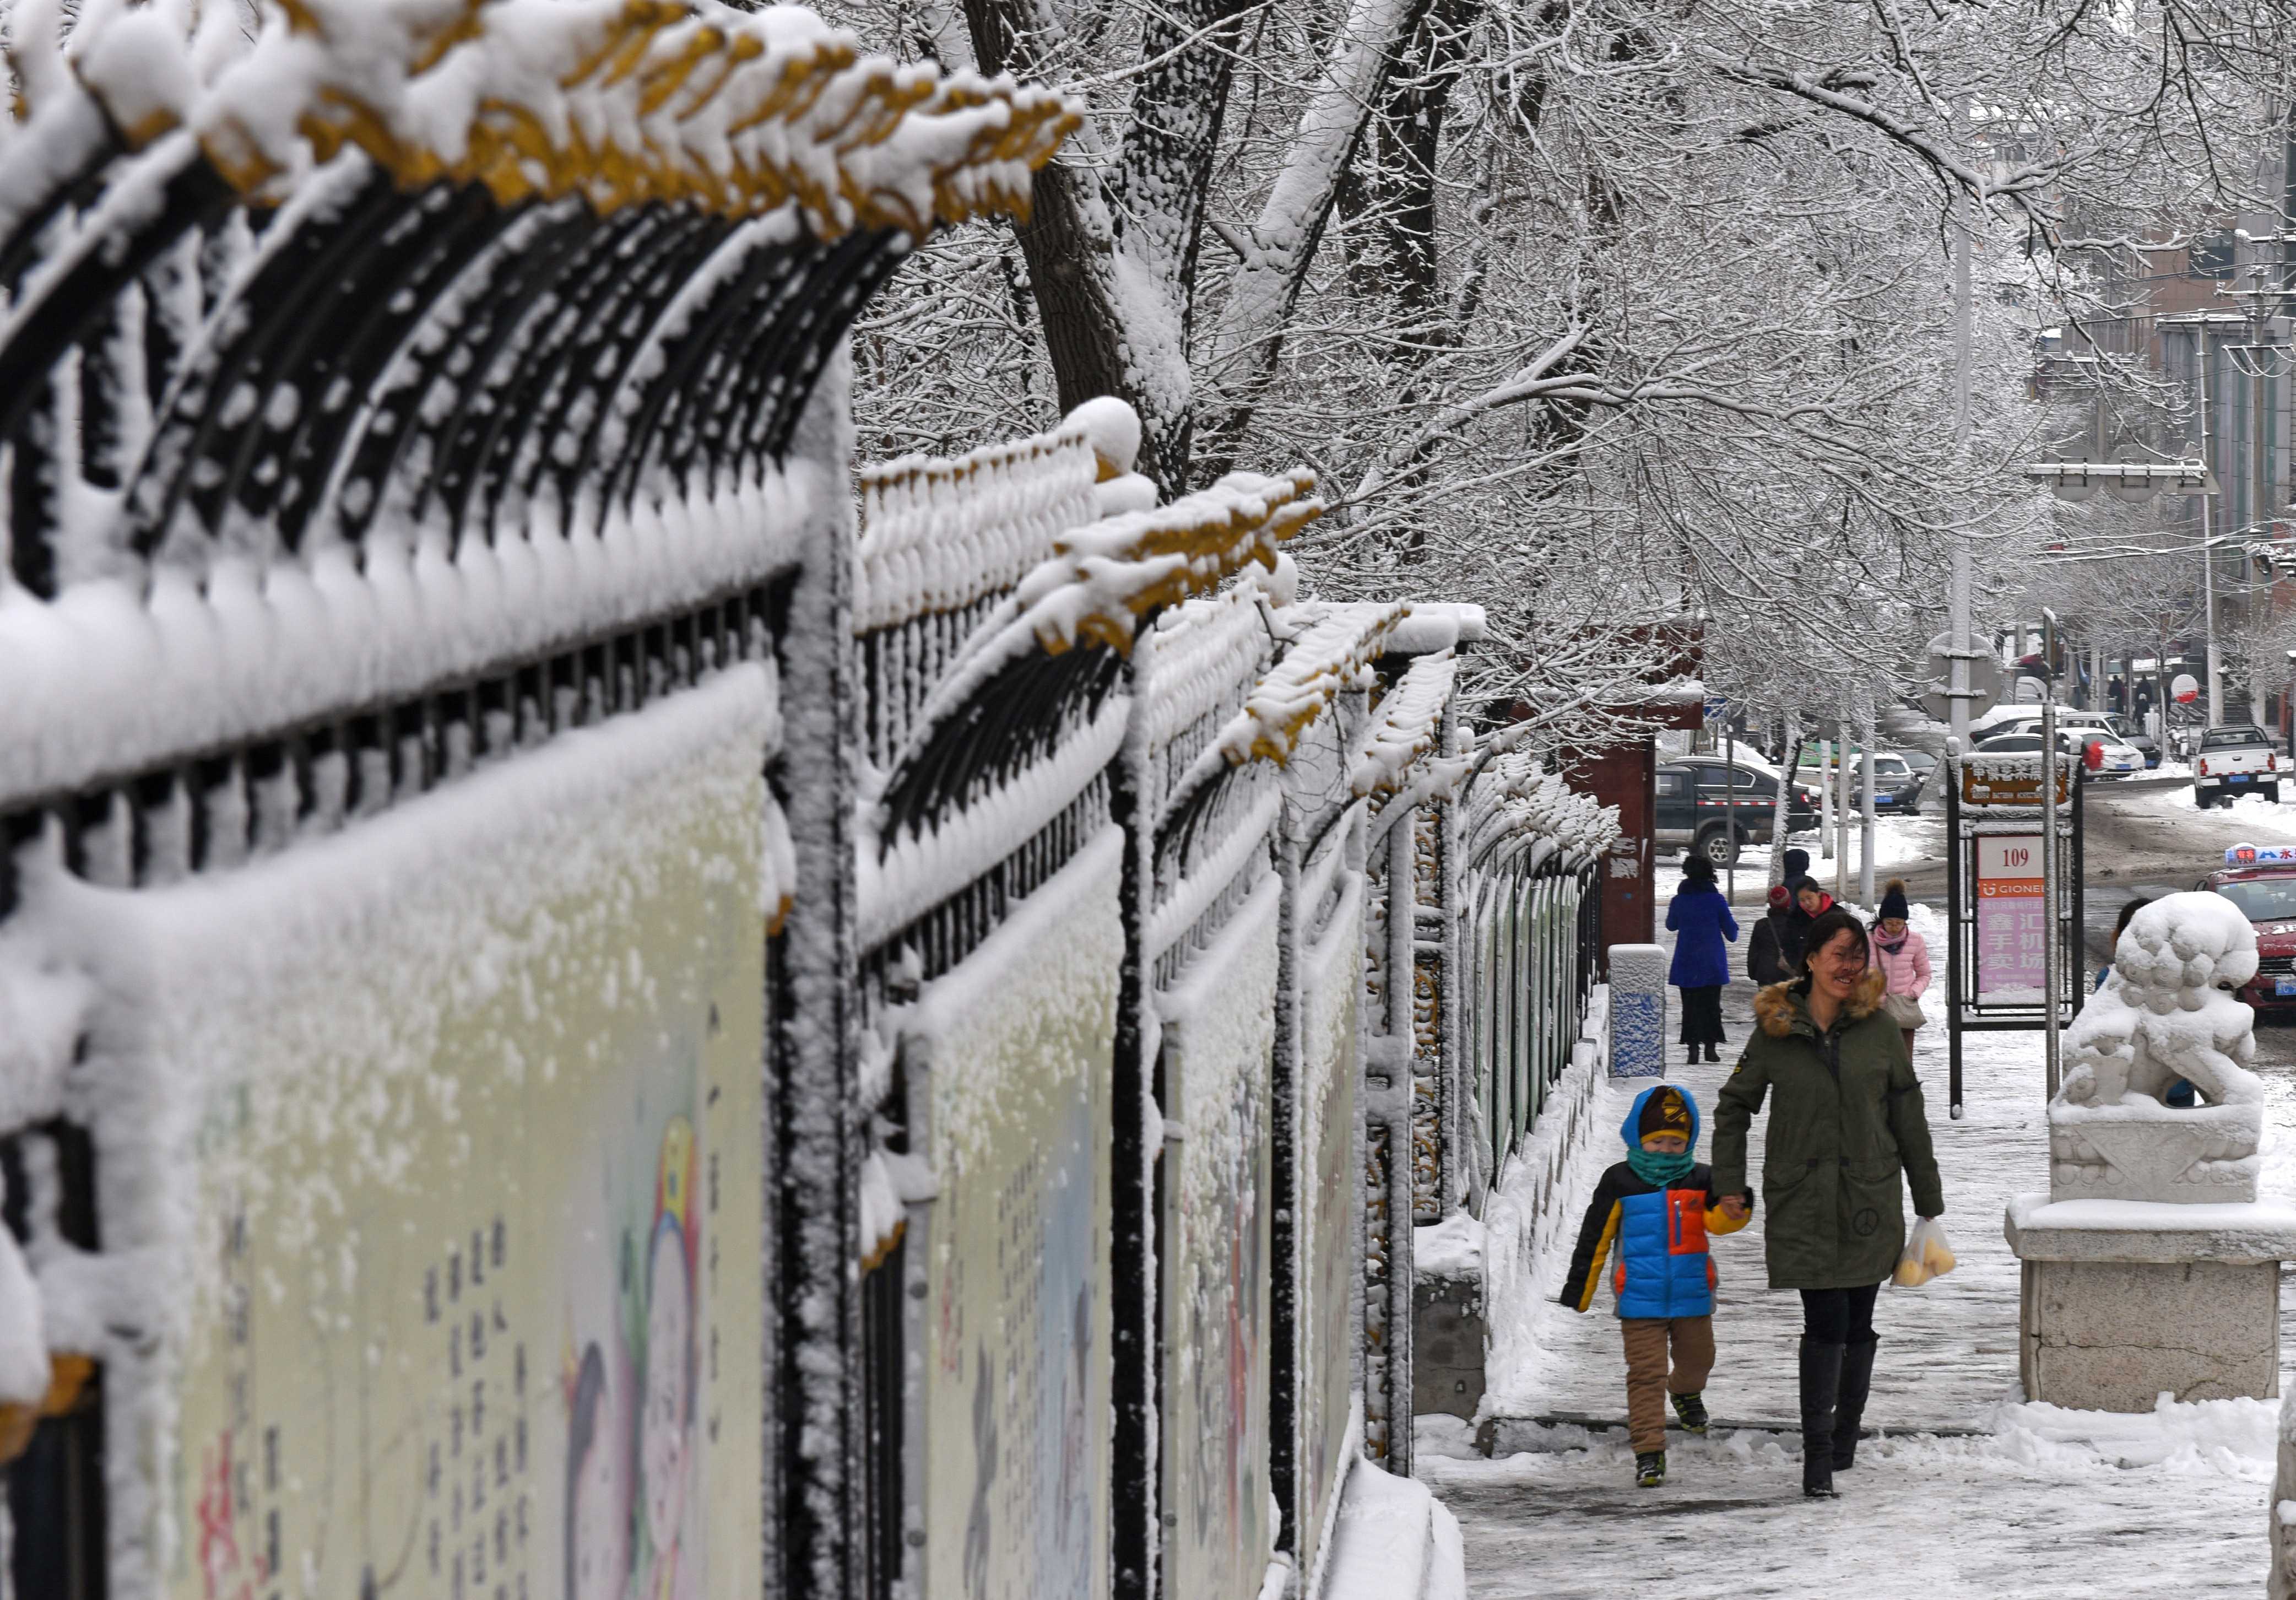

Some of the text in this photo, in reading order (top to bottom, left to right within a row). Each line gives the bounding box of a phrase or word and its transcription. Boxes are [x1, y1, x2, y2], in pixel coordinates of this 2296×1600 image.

[2002, 848, 2028, 867] 109
[2279, 849, 2296, 860] 永
[1987, 913, 2045, 930] 鑫汇
[1987, 933, 2045, 950] 手机
[1987, 953, 2045, 970] 卖场
